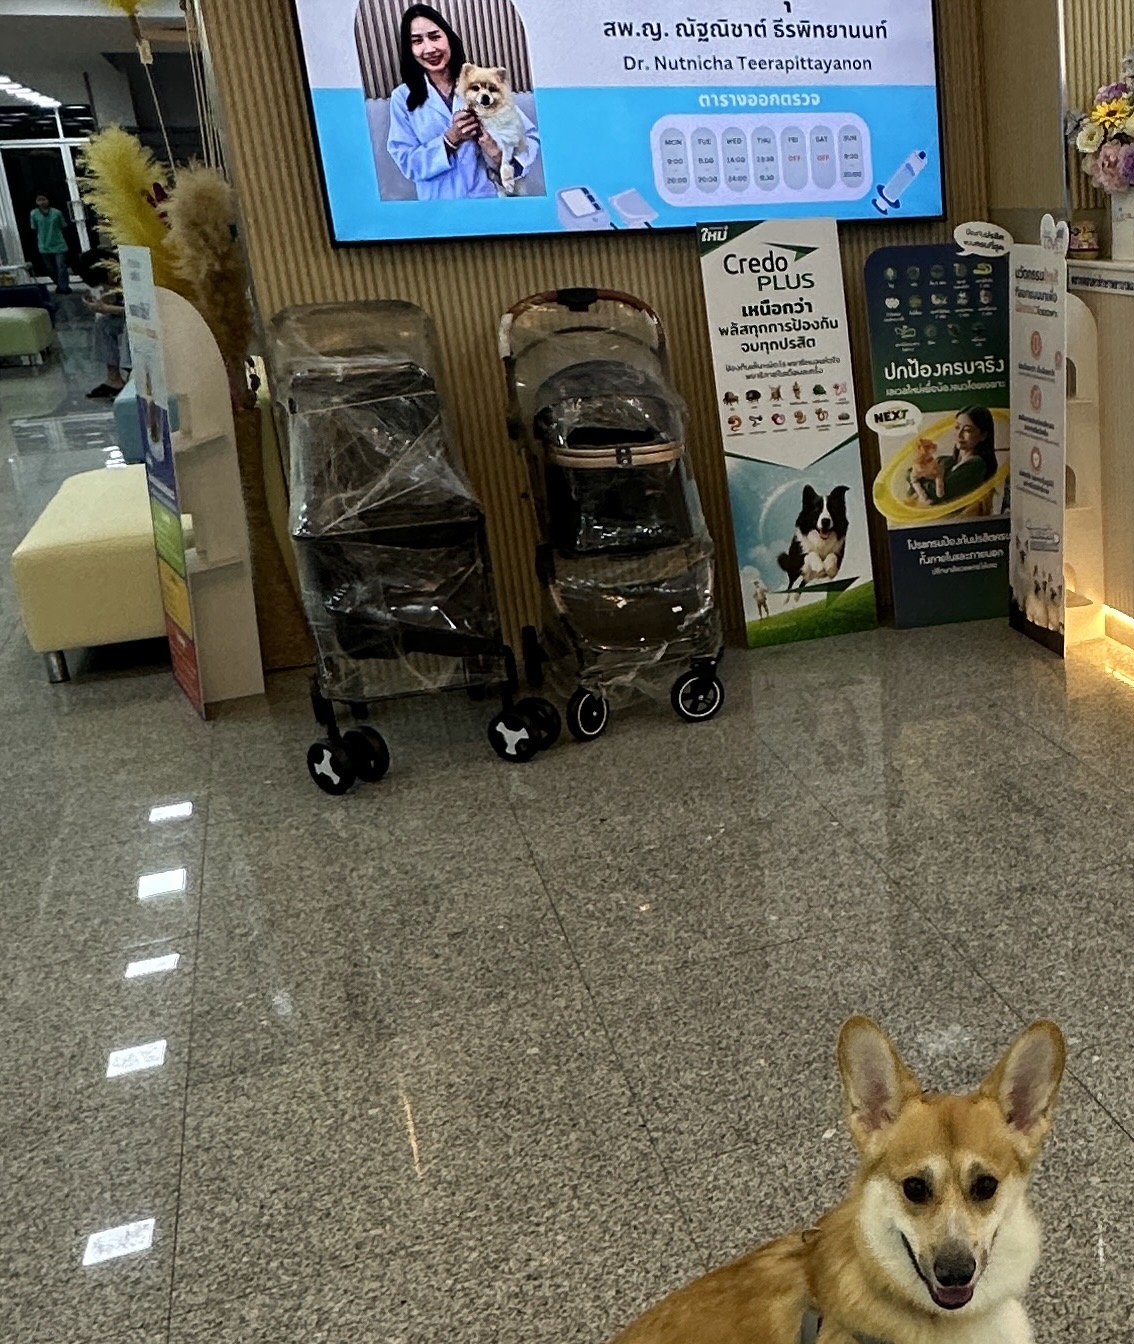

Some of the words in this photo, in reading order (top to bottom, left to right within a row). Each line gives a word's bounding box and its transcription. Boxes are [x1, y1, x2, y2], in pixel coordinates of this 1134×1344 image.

[603, 20, 669, 41] สพ.ญ.
[675, 17, 767, 43] ณัฐณิชาต์
[773, 18, 888, 40] ธีรพิทยานนท์
[623, 55, 650, 71] Dr.
[655, 55, 733, 71] Nutnicha
[737, 56, 873, 74] Teerapittayanon
[698, 92, 821, 107] ตารางออกตรวจ
[701, 226, 729, 242] ใหม่
[723, 250, 788, 274] Credo
[757, 273, 815, 291] PLUS
[741, 297, 813, 317] เหนือกว่า
[718, 317, 839, 338] พลัสทุกการป้องกัน
[741, 336, 816, 354] จบทุกปรสิต
[884, 355, 1005, 380] ปกป้องครบจริง
[873, 408, 909, 423] NEXT
